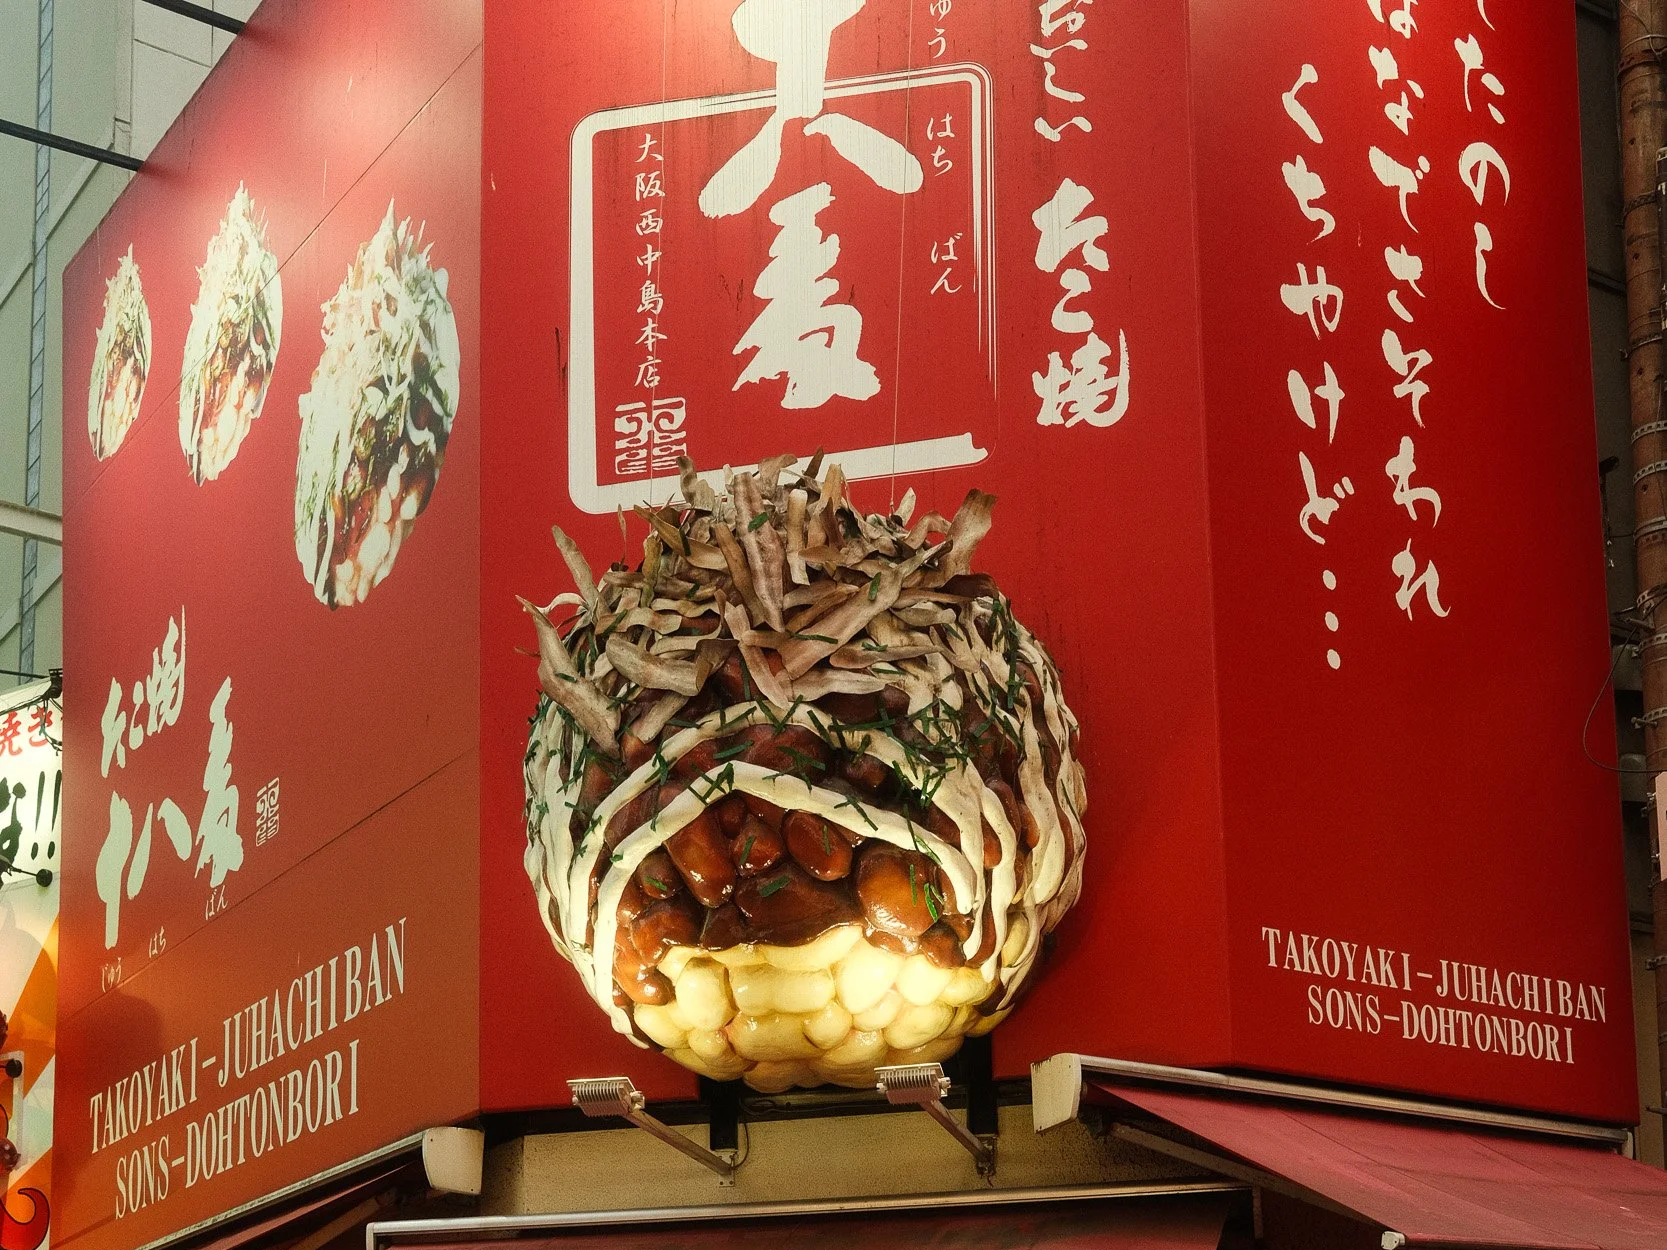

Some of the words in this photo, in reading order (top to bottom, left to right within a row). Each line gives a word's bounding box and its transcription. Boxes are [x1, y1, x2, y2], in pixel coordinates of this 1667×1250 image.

[635, 134, 668, 389] 大阪西中島本店
[89, 918, 408, 1154] TAKOYAKI-JUHACHIBAN
[1262, 926, 1607, 1023] TAKOYAKI-JUHACHIBAN
[1308, 984, 1575, 1064] SONS-DOHTONBORI
[115, 1040, 359, 1219] SONS-DOHTONBORI
